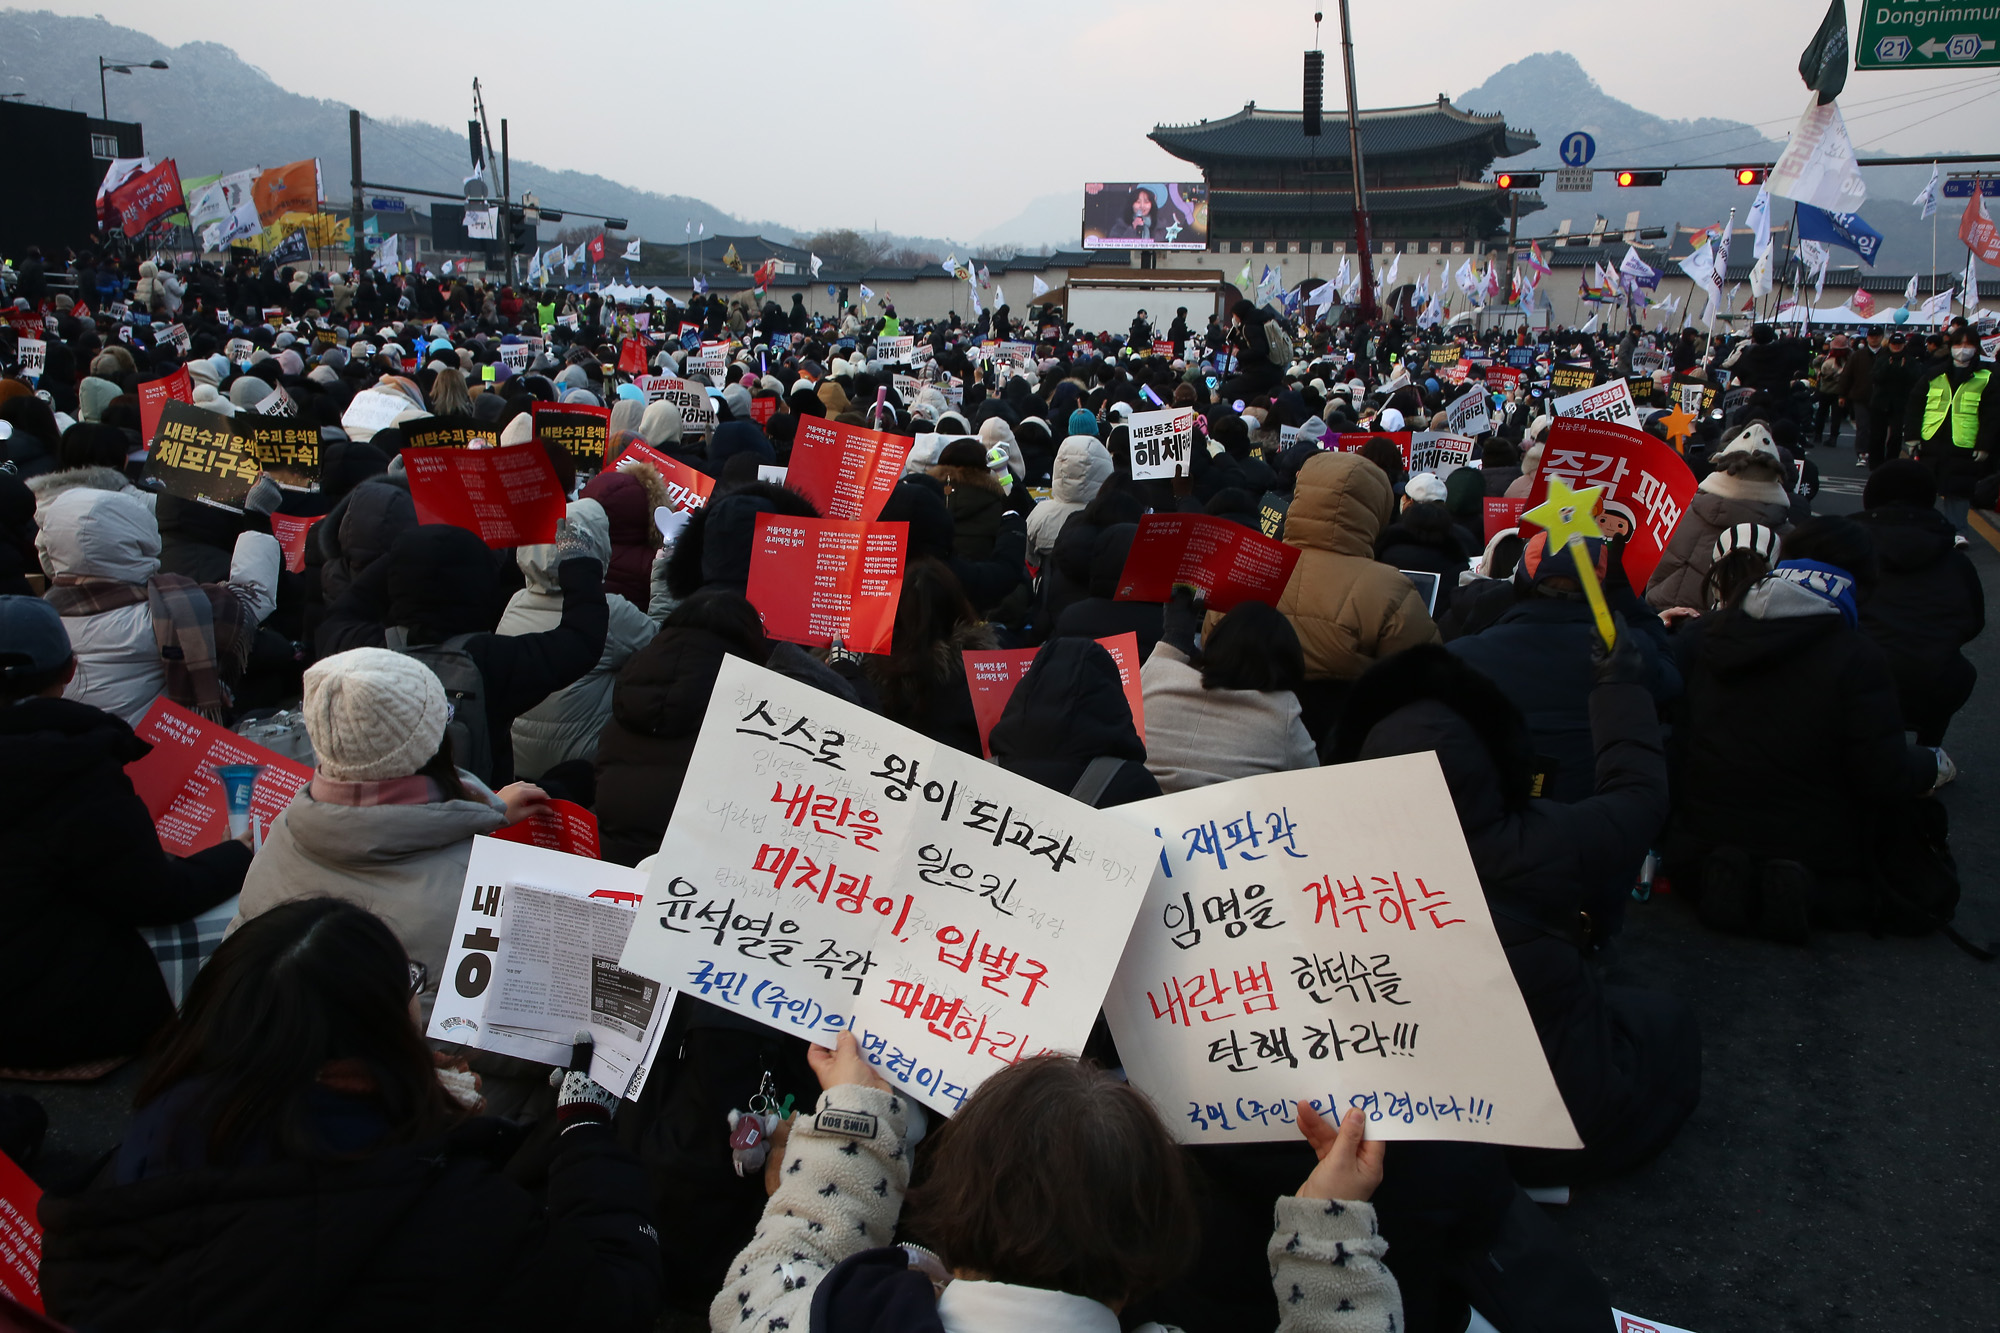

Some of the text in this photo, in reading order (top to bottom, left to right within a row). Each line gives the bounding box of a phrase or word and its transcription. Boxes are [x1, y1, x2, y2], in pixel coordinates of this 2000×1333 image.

[1882, 41, 1905, 57] 21
[1952, 39, 1974, 55] 50
[1552, 376, 1593, 389] 체포!구속!
[1584, 387, 1624, 411] 국민의힘
[164, 421, 229, 450] 내란수괴
[284, 430, 318, 445] 윤석열
[410, 429, 465, 448] 내란수괴
[540, 425, 606, 439] 내란수괴 윤석열
[1133, 423, 1174, 439] 내란동조
[1557, 422, 1643, 445] 나눔문화 www.nanum.com
[257, 444, 319, 467] 포!구속!
[1412, 438, 1471, 452] 내란동조 국민의힘
[1411, 450, 1468, 472] 해체하라
[1542, 449, 1682, 552] 즉각 파면
[765, 536, 804, 547] 우리에겐 빛이
[766, 526, 806, 537] 저들에겐 총이
[974, 661, 1007, 671] 저들에겐 총이
[735, 699, 847, 771] 스스로
[870, 753, 958, 822] 왕이
[963, 800, 1077, 873] 되고자
[771, 780, 1016, 916] 내란을 일으킨
[1182, 806, 1309, 871] 재판관
[1163, 871, 1467, 950] 임명을 거부하는
[657, 876, 804, 968] 윤석열을
[803, 938, 879, 997] 즉각
[936, 925, 1050, 1007] 입벌구
[1146, 951, 1412, 1027] 내란범 한덕수를
[880, 978, 1055, 1067] 파면하라
[687, 959, 746, 1008] 국민
[752, 978, 857, 1034] (주인)의
[861, 1028, 970, 1112] 명령이다
[821, 1116, 870, 1134] VIMS BOA
[1186, 1100, 1237, 1131] 국민
